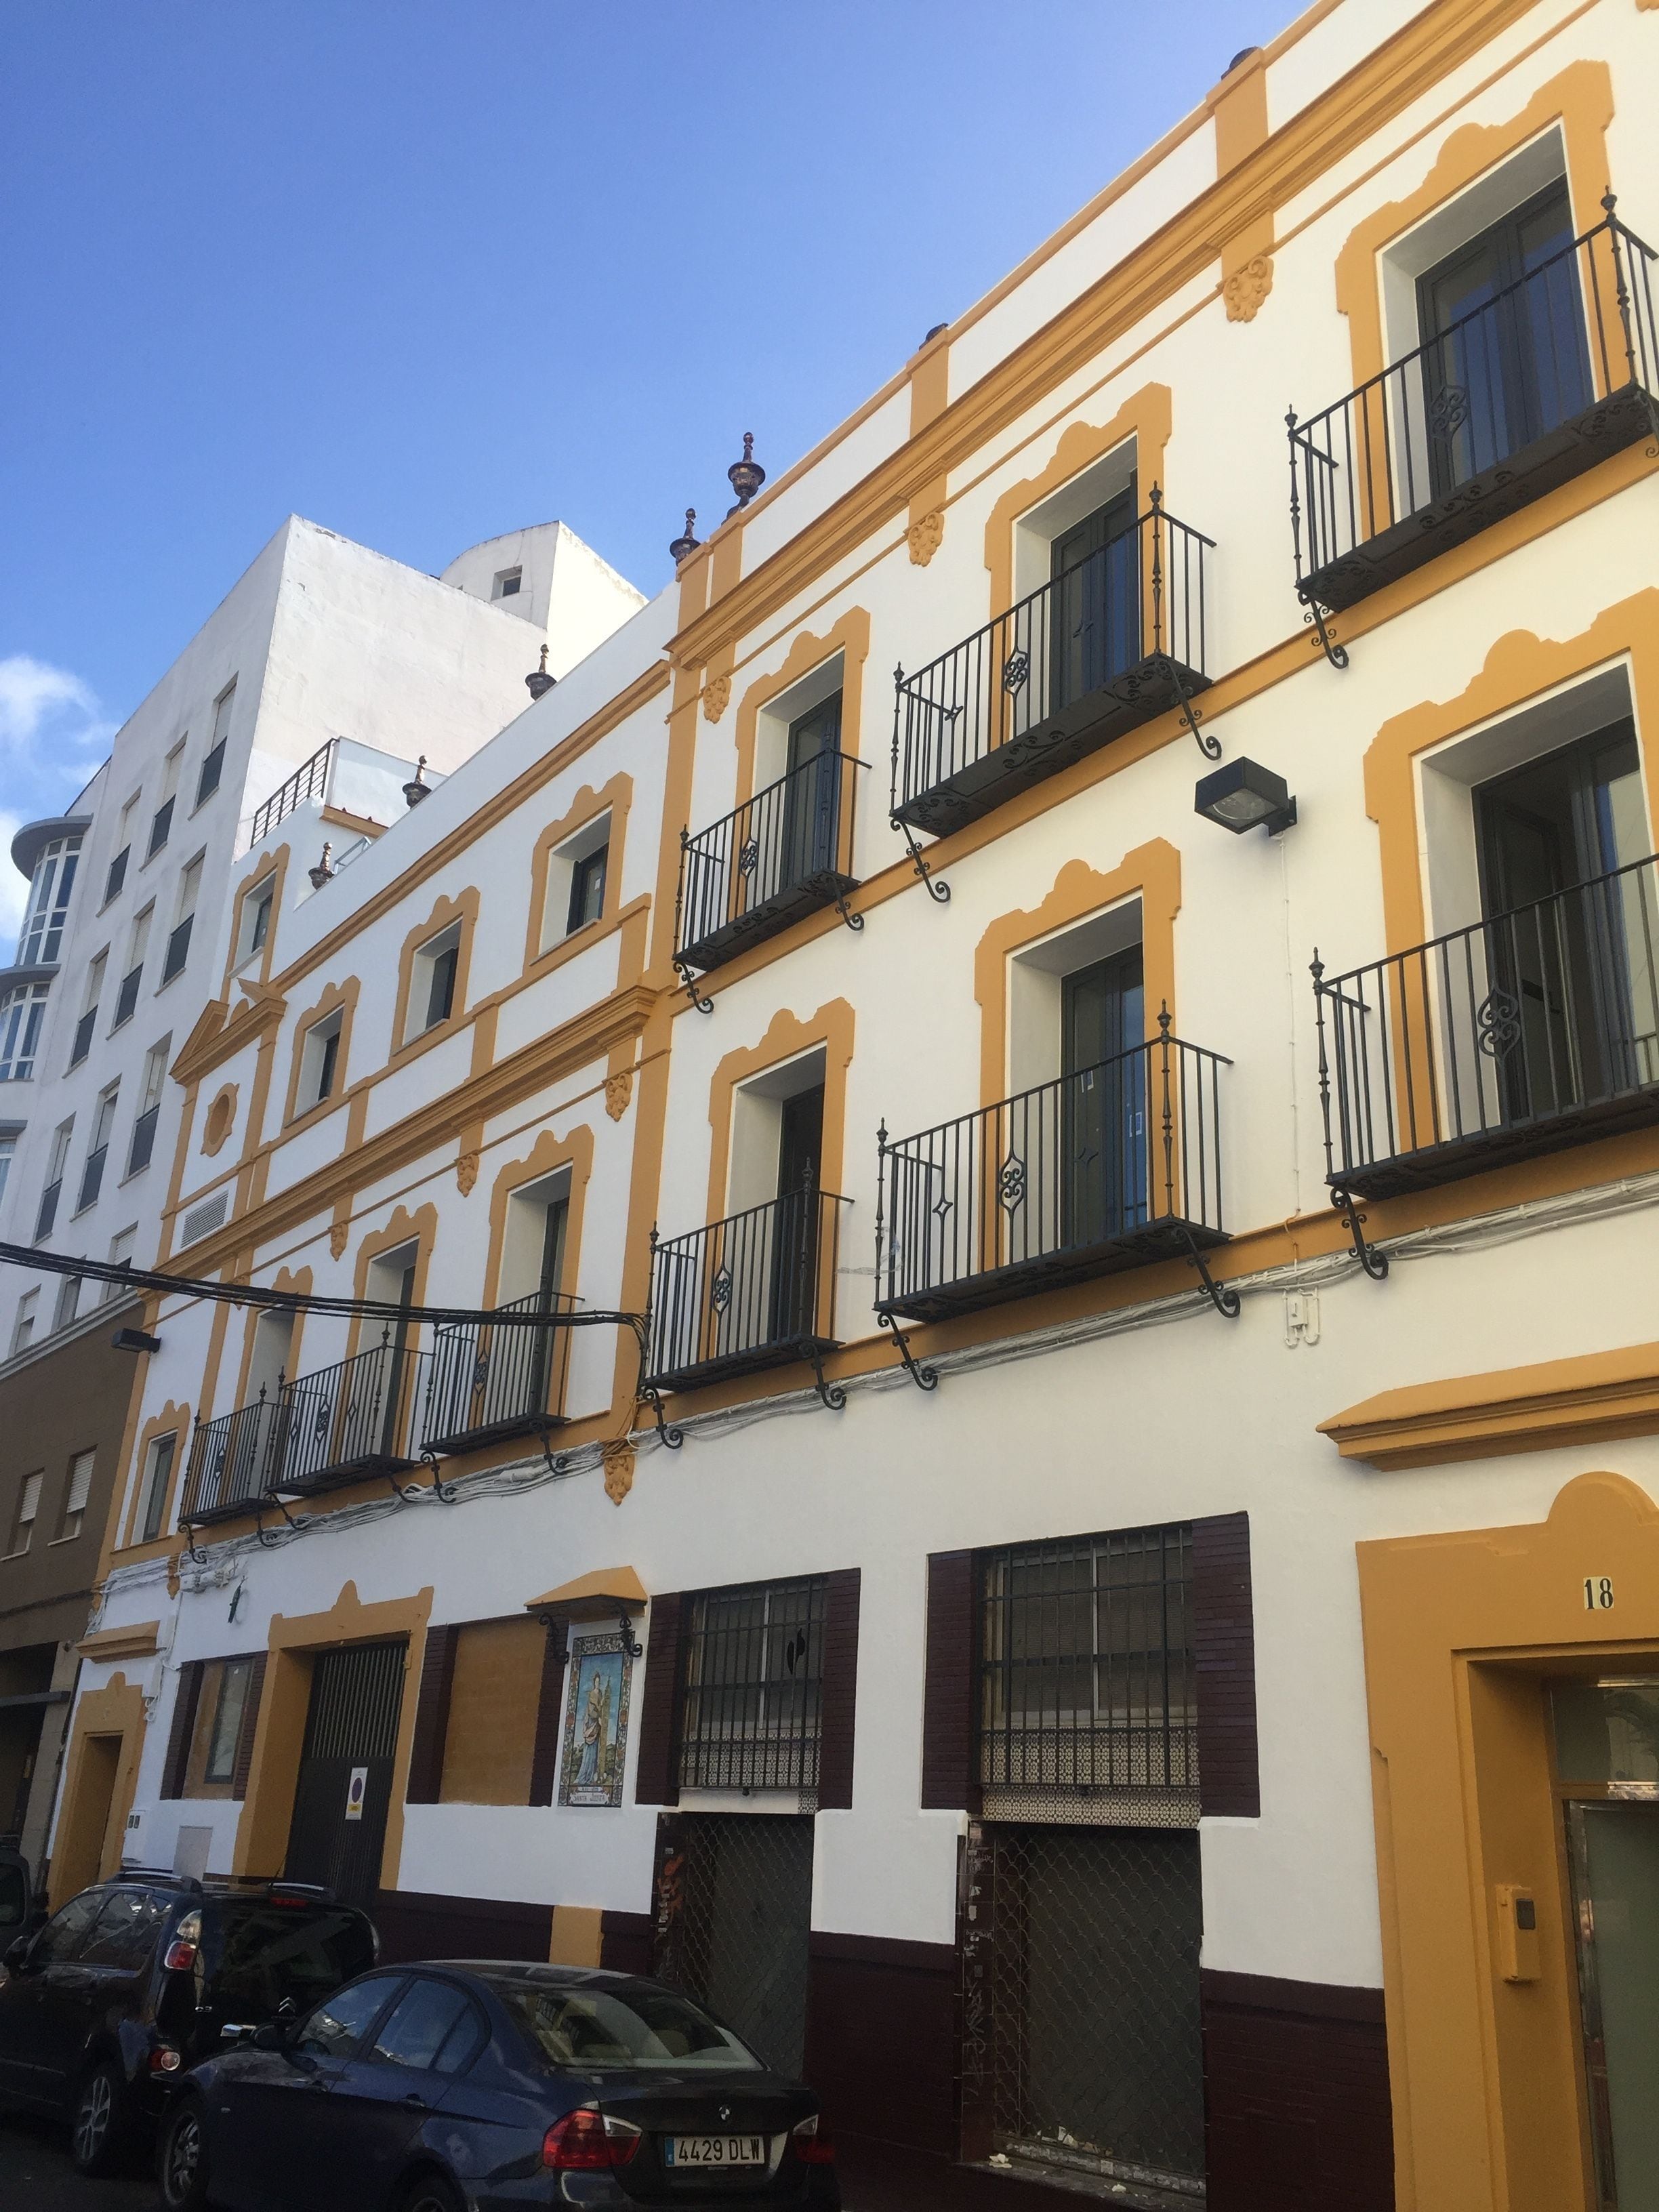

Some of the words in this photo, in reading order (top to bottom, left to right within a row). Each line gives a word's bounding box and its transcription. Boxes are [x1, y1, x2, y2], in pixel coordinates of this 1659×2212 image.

[1584, 1578, 1614, 1610] 18
[678, 2139, 723, 2162] 4429
[729, 2138, 760, 2160] DLW
